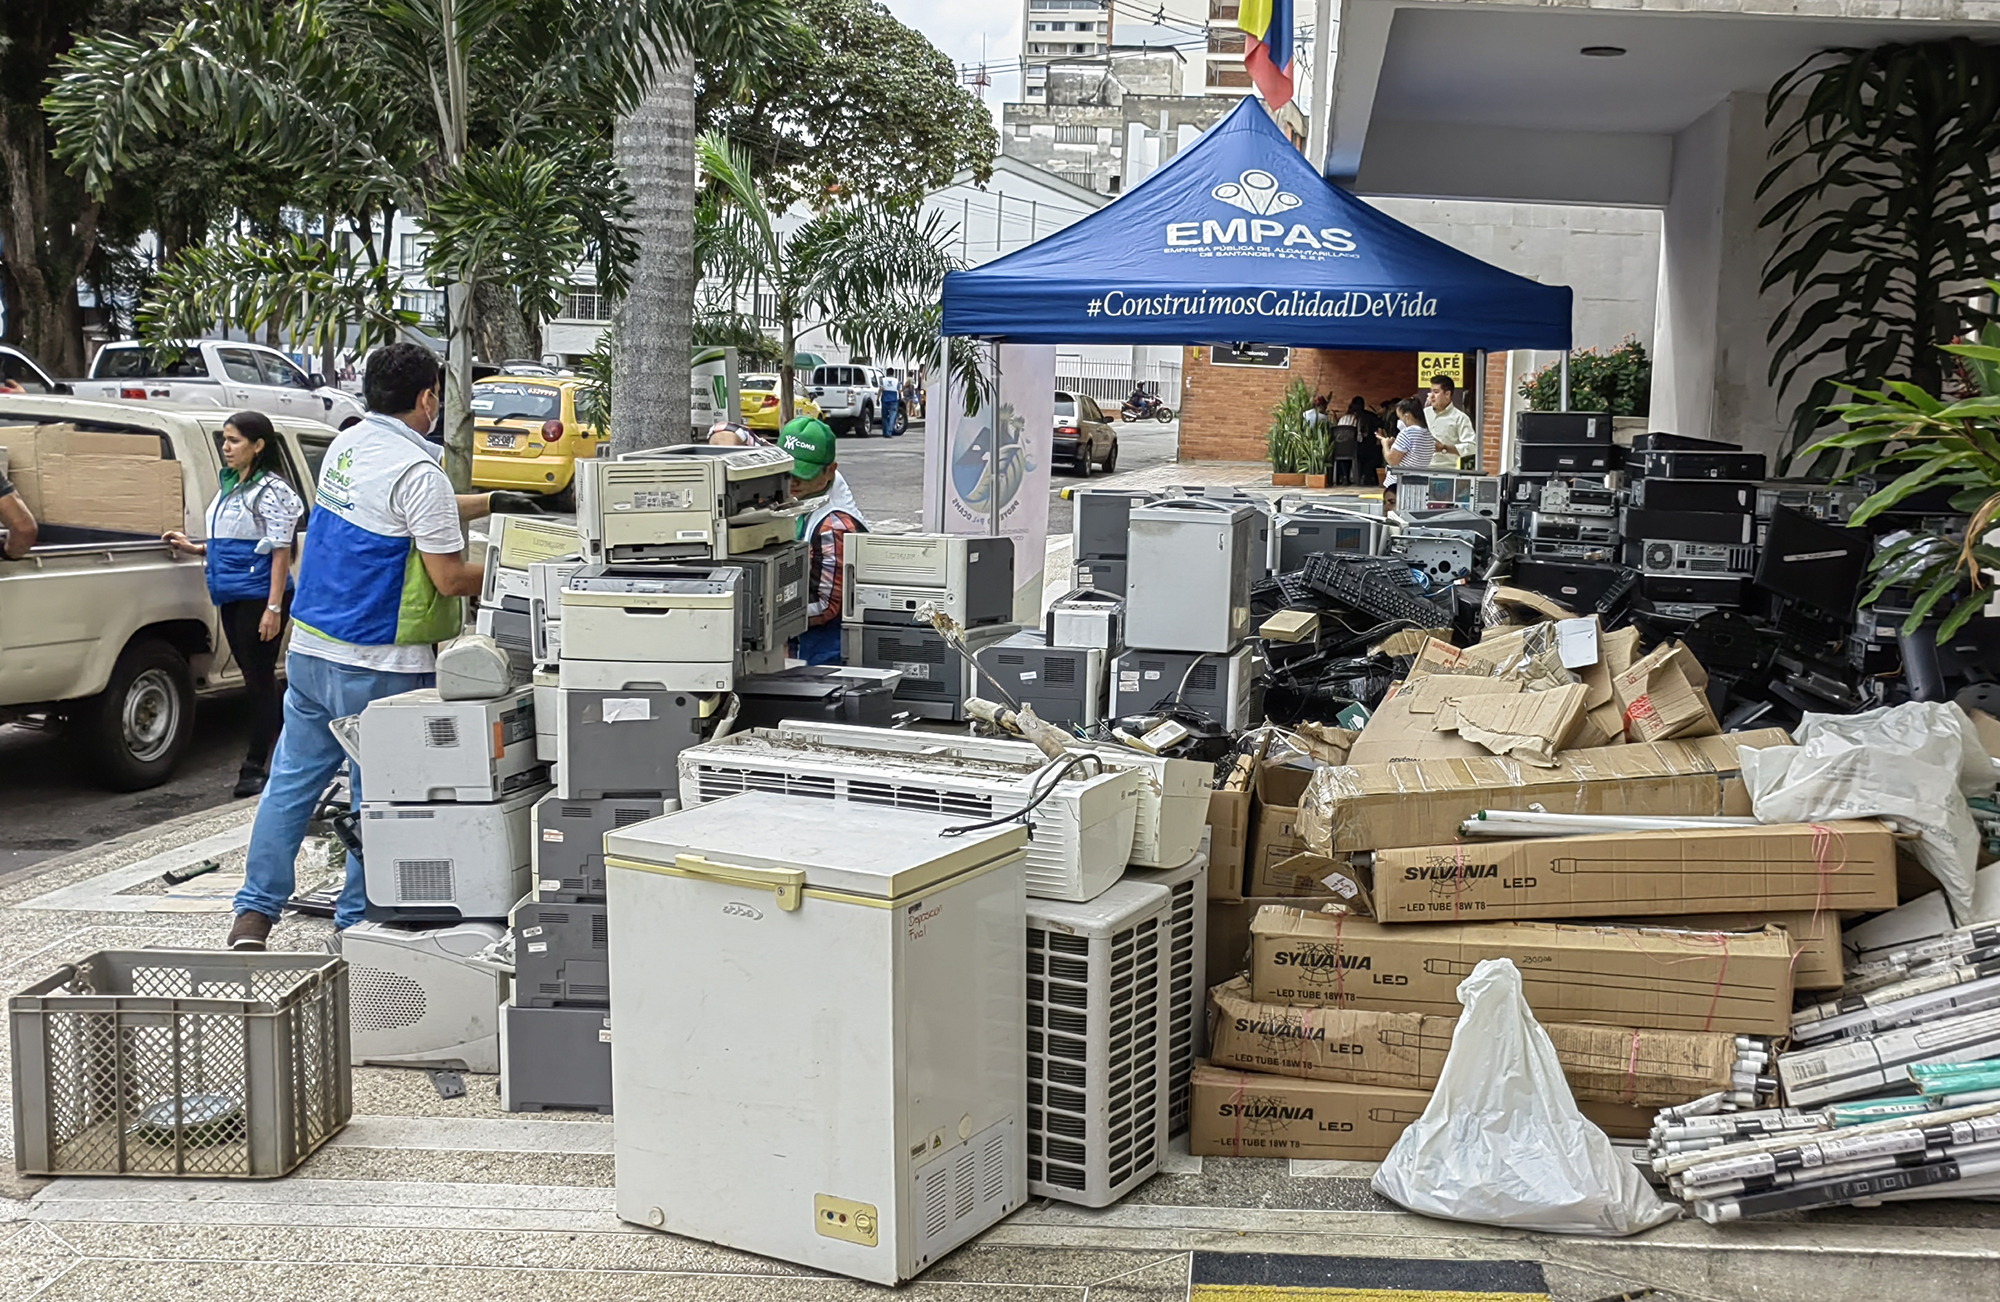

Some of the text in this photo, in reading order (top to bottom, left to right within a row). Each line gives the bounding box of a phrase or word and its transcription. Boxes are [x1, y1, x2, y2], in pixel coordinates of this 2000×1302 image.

[1166, 218, 1357, 252] EMPAS
[1164, 246, 1211, 254] EMPRESA
[1213, 244, 1255, 252] PÚBLICA
[1274, 247, 1361, 259] ALCANTARILLADO
[1216, 251, 1275, 259] SANTANDER
[1086, 289, 1438, 318] #ConstruimosCalidadDeVida
[1421, 354, 1460, 369] CAFÉ
[1433, 369, 1460, 377] Grano
[1404, 864, 1498, 880] SYLVANIA
[1503, 877, 1537, 888] LED
[1407, 902, 1486, 911] LED TUBE 18W T8
[1273, 951, 1372, 970] SYLVANIA
[1373, 974, 1409, 985] LED
[1276, 989, 1356, 1001] LED TUBE 18W T8
[1234, 1018, 1326, 1041] SYLVANIA
[1330, 1043, 1364, 1055] LED
[1235, 1053, 1313, 1069] LED TUBE 18W T8
[1218, 1104, 1314, 1121] SYLVANIA
[1318, 1121, 1354, 1132] LED
[1220, 1137, 1300, 1148] LED TUBE 18W T8
